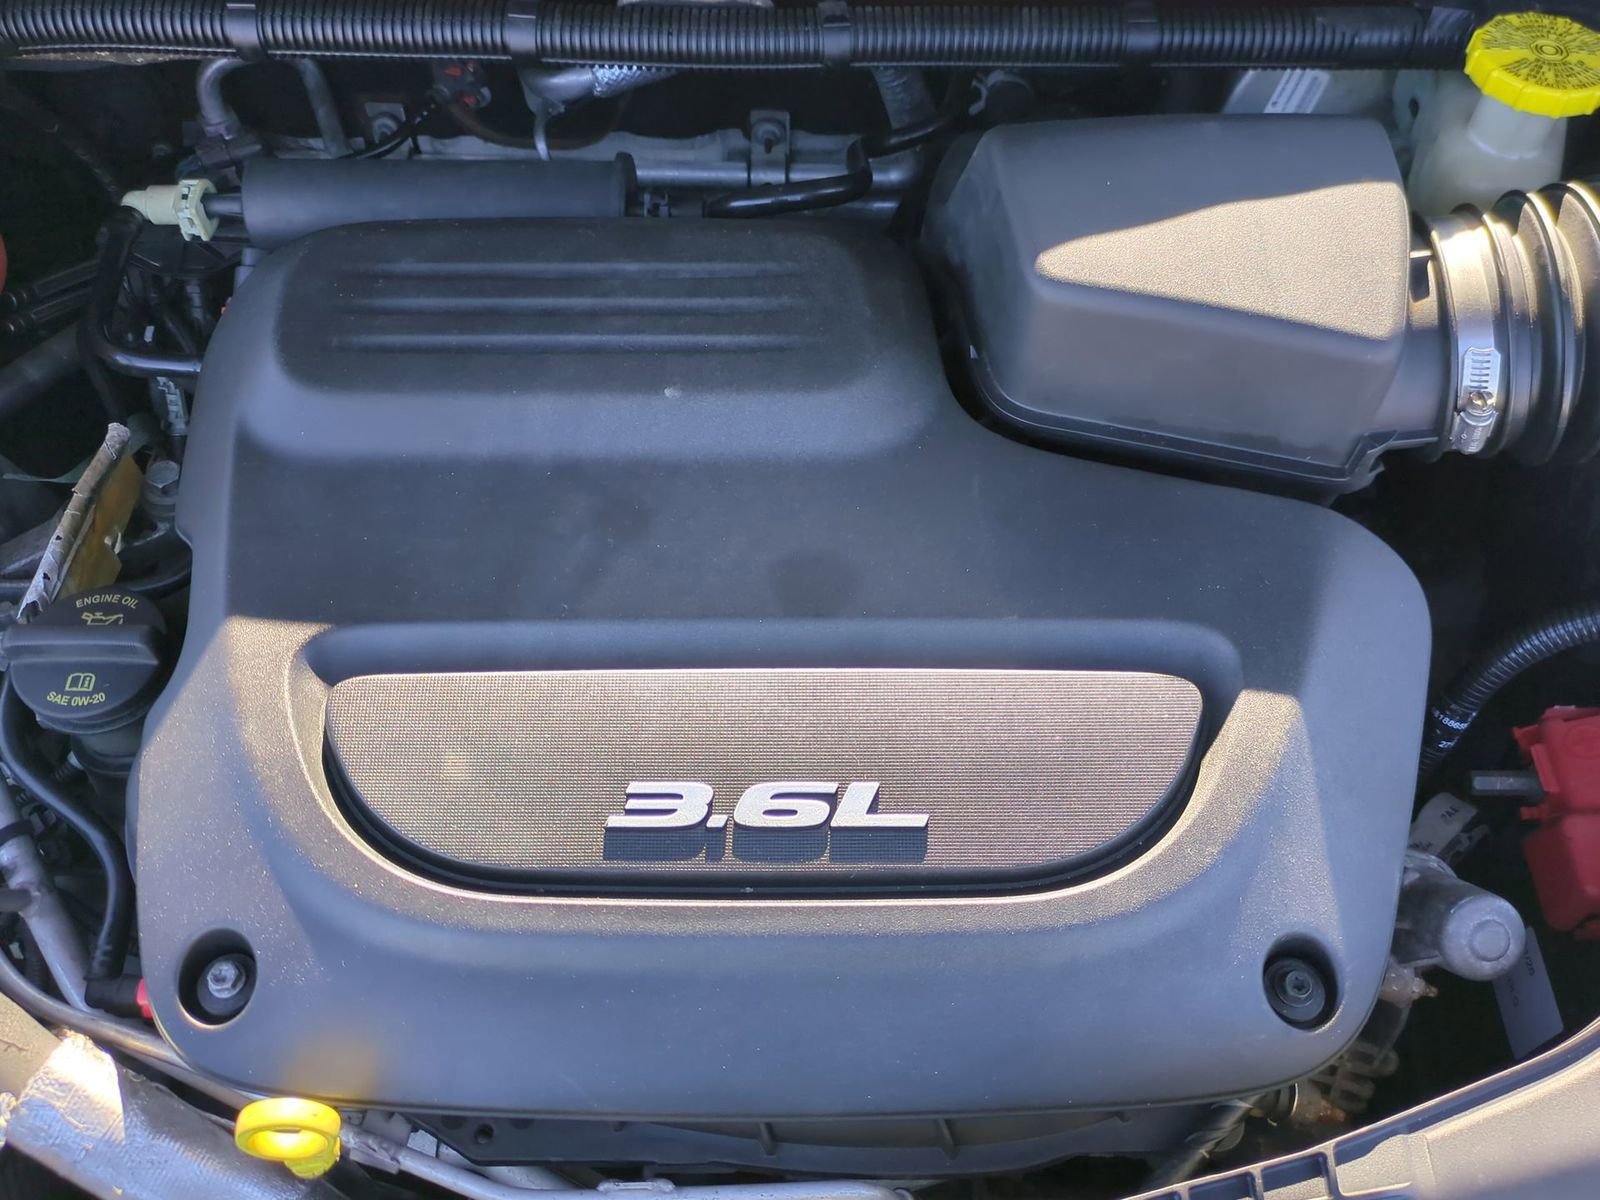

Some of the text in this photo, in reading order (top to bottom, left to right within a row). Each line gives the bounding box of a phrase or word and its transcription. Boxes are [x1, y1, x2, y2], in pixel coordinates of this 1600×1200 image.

[75, 594, 139, 609] ENGINE OIL
[47, 691, 106, 707] SAE 0W-20
[604, 781, 929, 829] 3.6L
